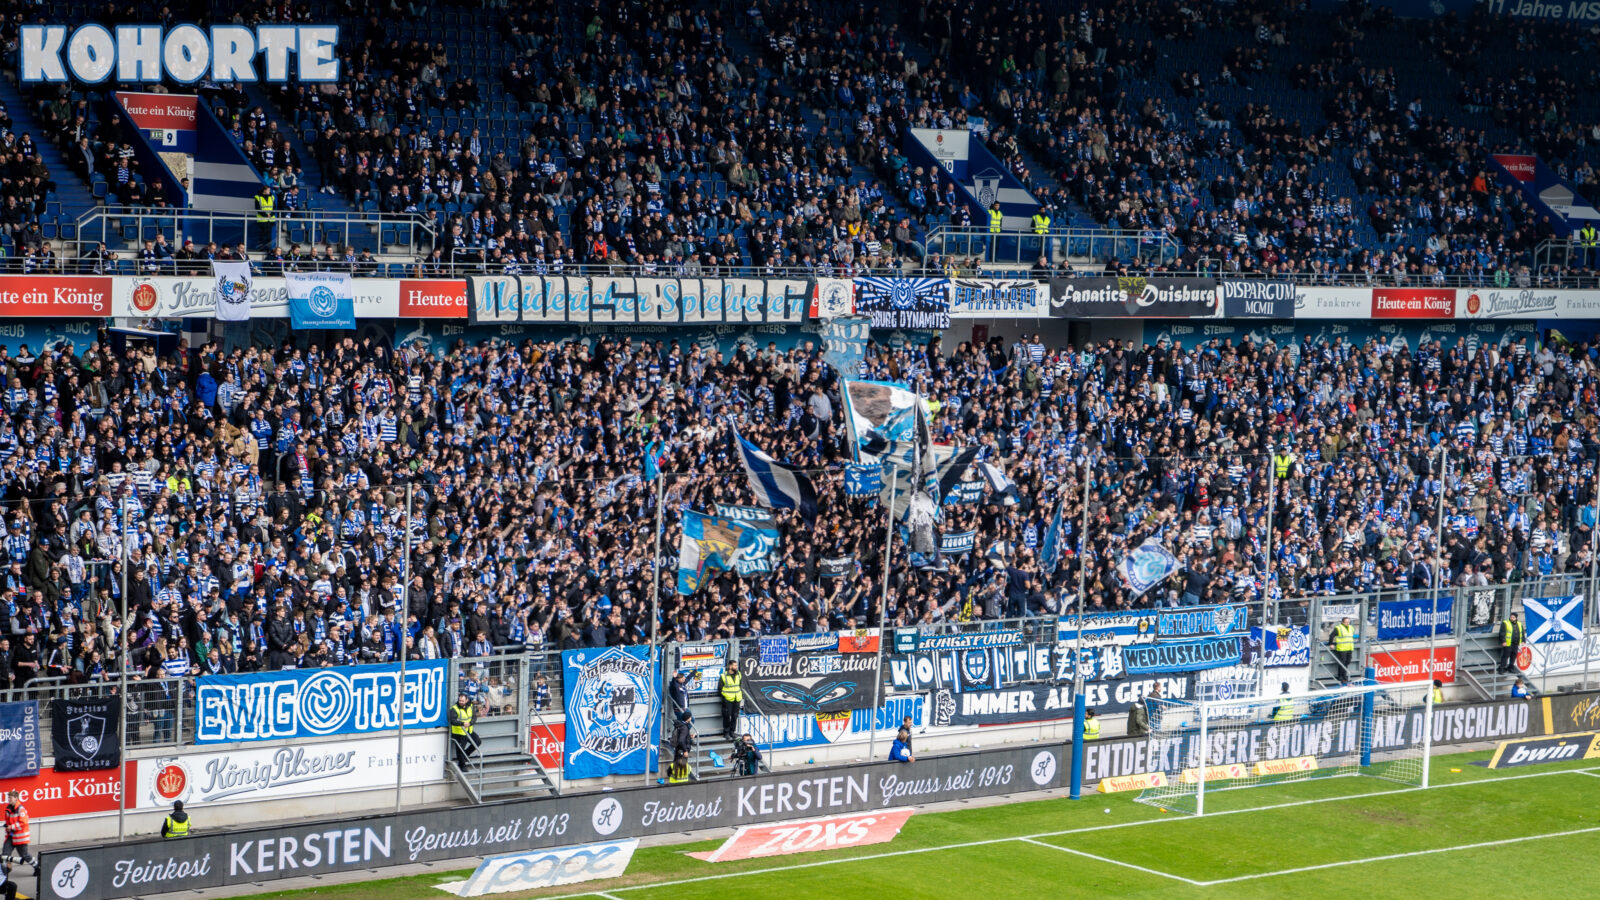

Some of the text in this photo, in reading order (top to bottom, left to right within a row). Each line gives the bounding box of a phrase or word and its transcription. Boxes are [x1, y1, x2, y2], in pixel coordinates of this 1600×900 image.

[1510, 0, 1563, 18] Jahre
[123, 98, 196, 121] eute ein König
[166, 132, 173, 143] 9
[22, 288, 51, 306] ein
[53, 287, 103, 311] König
[408, 289, 452, 306] Heute
[1137, 284, 1215, 308] Duisburg
[1224, 281, 1296, 300] DISPARGUM
[968, 300, 1023, 310] DUISBURG
[1245, 301, 1274, 315] MCMII
[1317, 297, 1361, 308] Fankurve
[1376, 295, 1452, 314] Heute ein König
[1487, 289, 1557, 313] König Pilsener
[614, 325, 668, 333] WEDAUSTADION
[900, 311, 950, 328] DYNAMITES
[1159, 611, 1216, 636] METROPOL
[1381, 609, 1406, 629] Block
[1547, 633, 1565, 641] PTFC
[760, 646, 788, 654] STADION
[1125, 638, 1239, 668] WEDAUSTADION
[745, 655, 793, 677] Proud
[1402, 660, 1419, 675] ein
[197, 666, 444, 741] EWIG TREU
[962, 689, 1037, 716] IMMER
[1044, 684, 1109, 710] ALES
[23, 706, 37, 770] DUISBURG
[1086, 737, 1183, 780] ENTDECKT
[1267, 721, 1333, 760] SHOWS
[1339, 719, 1358, 752] IN
[1372, 714, 1405, 748] ANZ
[1507, 741, 1580, 764] bwin
[201, 747, 356, 789] König Pilsener
[1264, 761, 1298, 773] Sinalco
[33, 781, 62, 801] ein
[67, 776, 122, 802] König
[1110, 778, 1146, 792] Sinalco
[112, 852, 211, 888] Feinkost
[230, 825, 392, 876] KERSTEN
[405, 826, 480, 861] Genuss
[484, 818, 521, 844] seit
[527, 813, 570, 839] 1913
[641, 796, 722, 826] Feinkost
[737, 773, 870, 817] KERSTEN
[880, 774, 941, 805] Genuss
[943, 768, 974, 791] seit
[978, 764, 1014, 787] 1913
